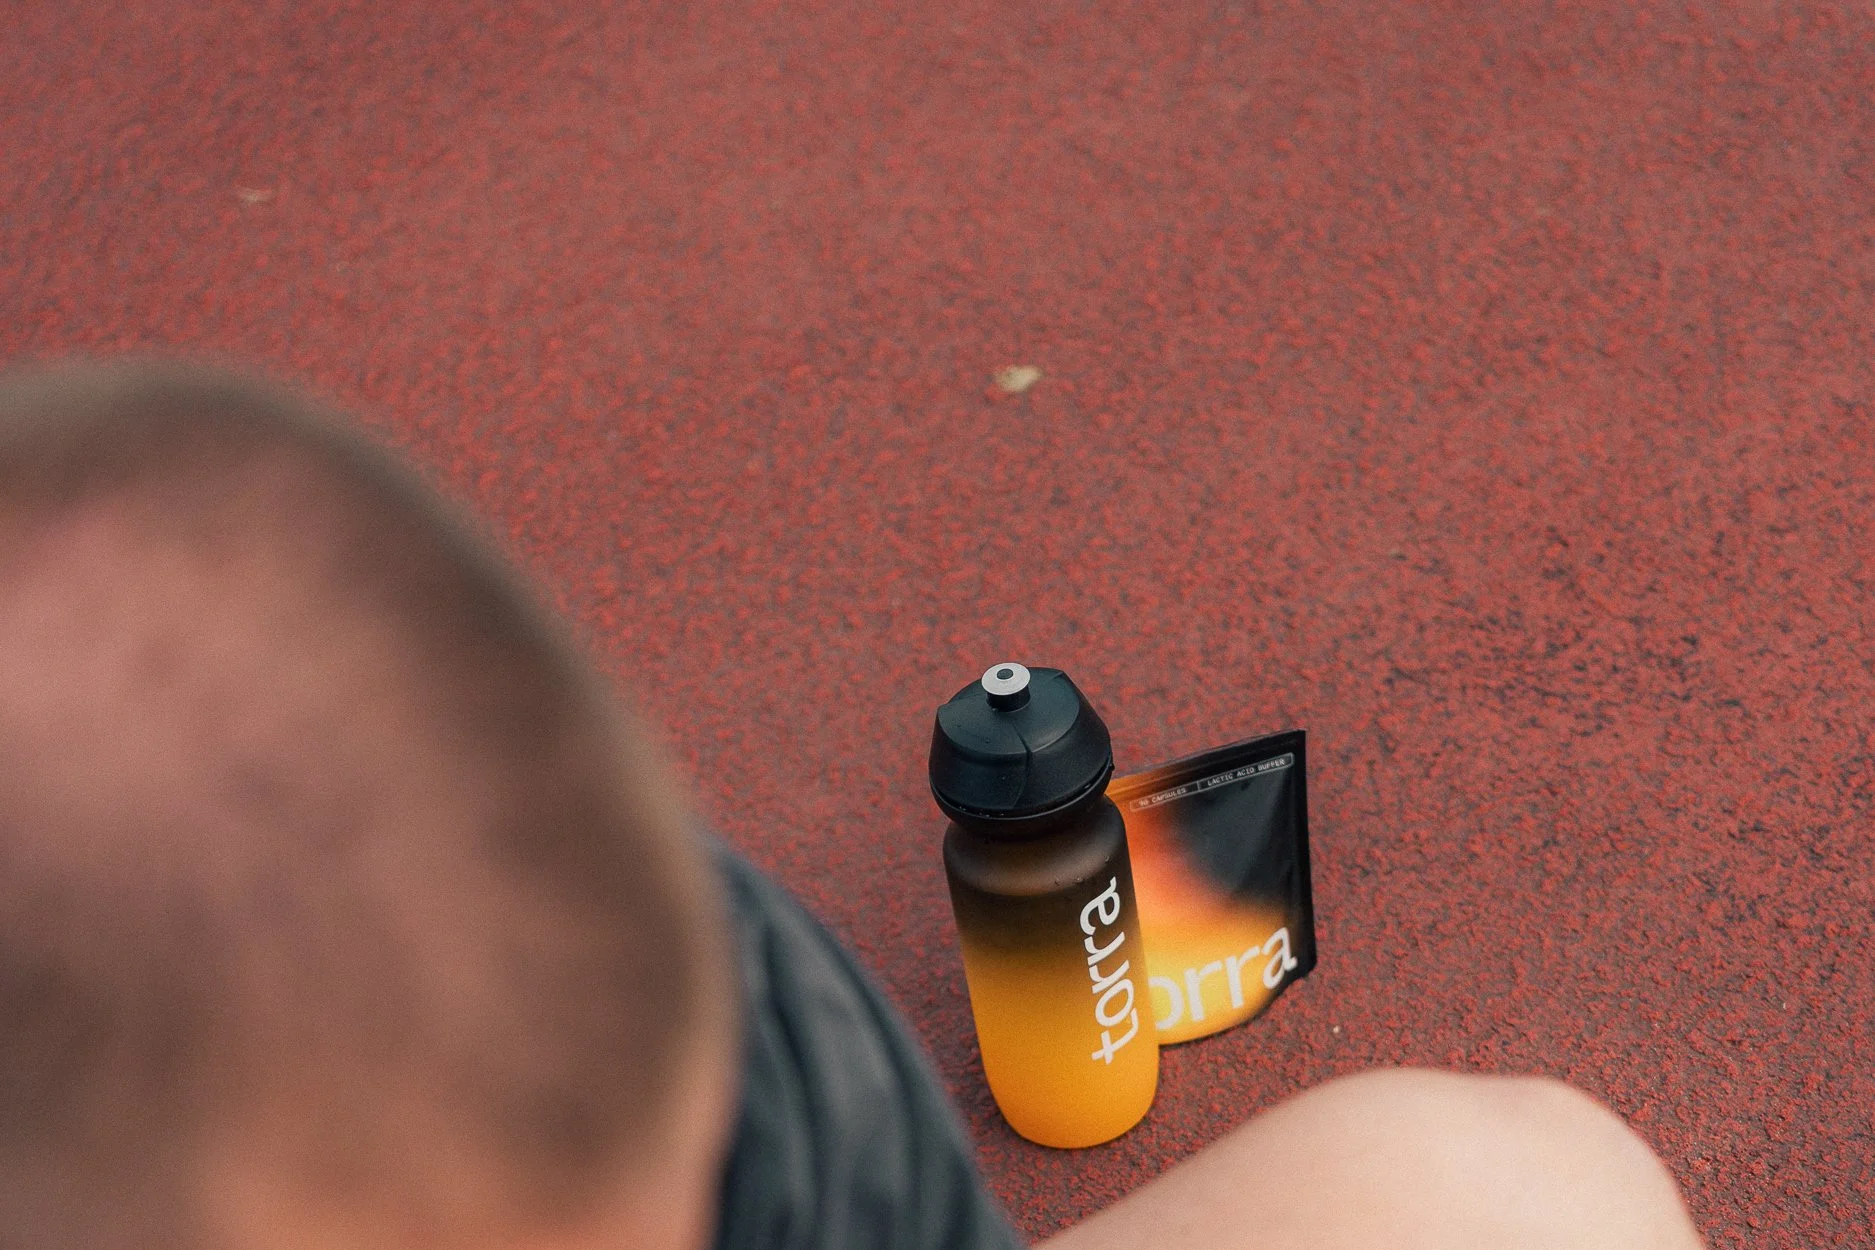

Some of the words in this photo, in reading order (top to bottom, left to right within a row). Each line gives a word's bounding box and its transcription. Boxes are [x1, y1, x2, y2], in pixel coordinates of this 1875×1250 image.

[1207, 773, 1234, 787] LACTIC
[1237, 766, 1255, 777] ACID
[1257, 758, 1286, 771] BUFFER
[1151, 787, 1187, 804] CAPSULES
[1080, 877, 1139, 1064] torra
